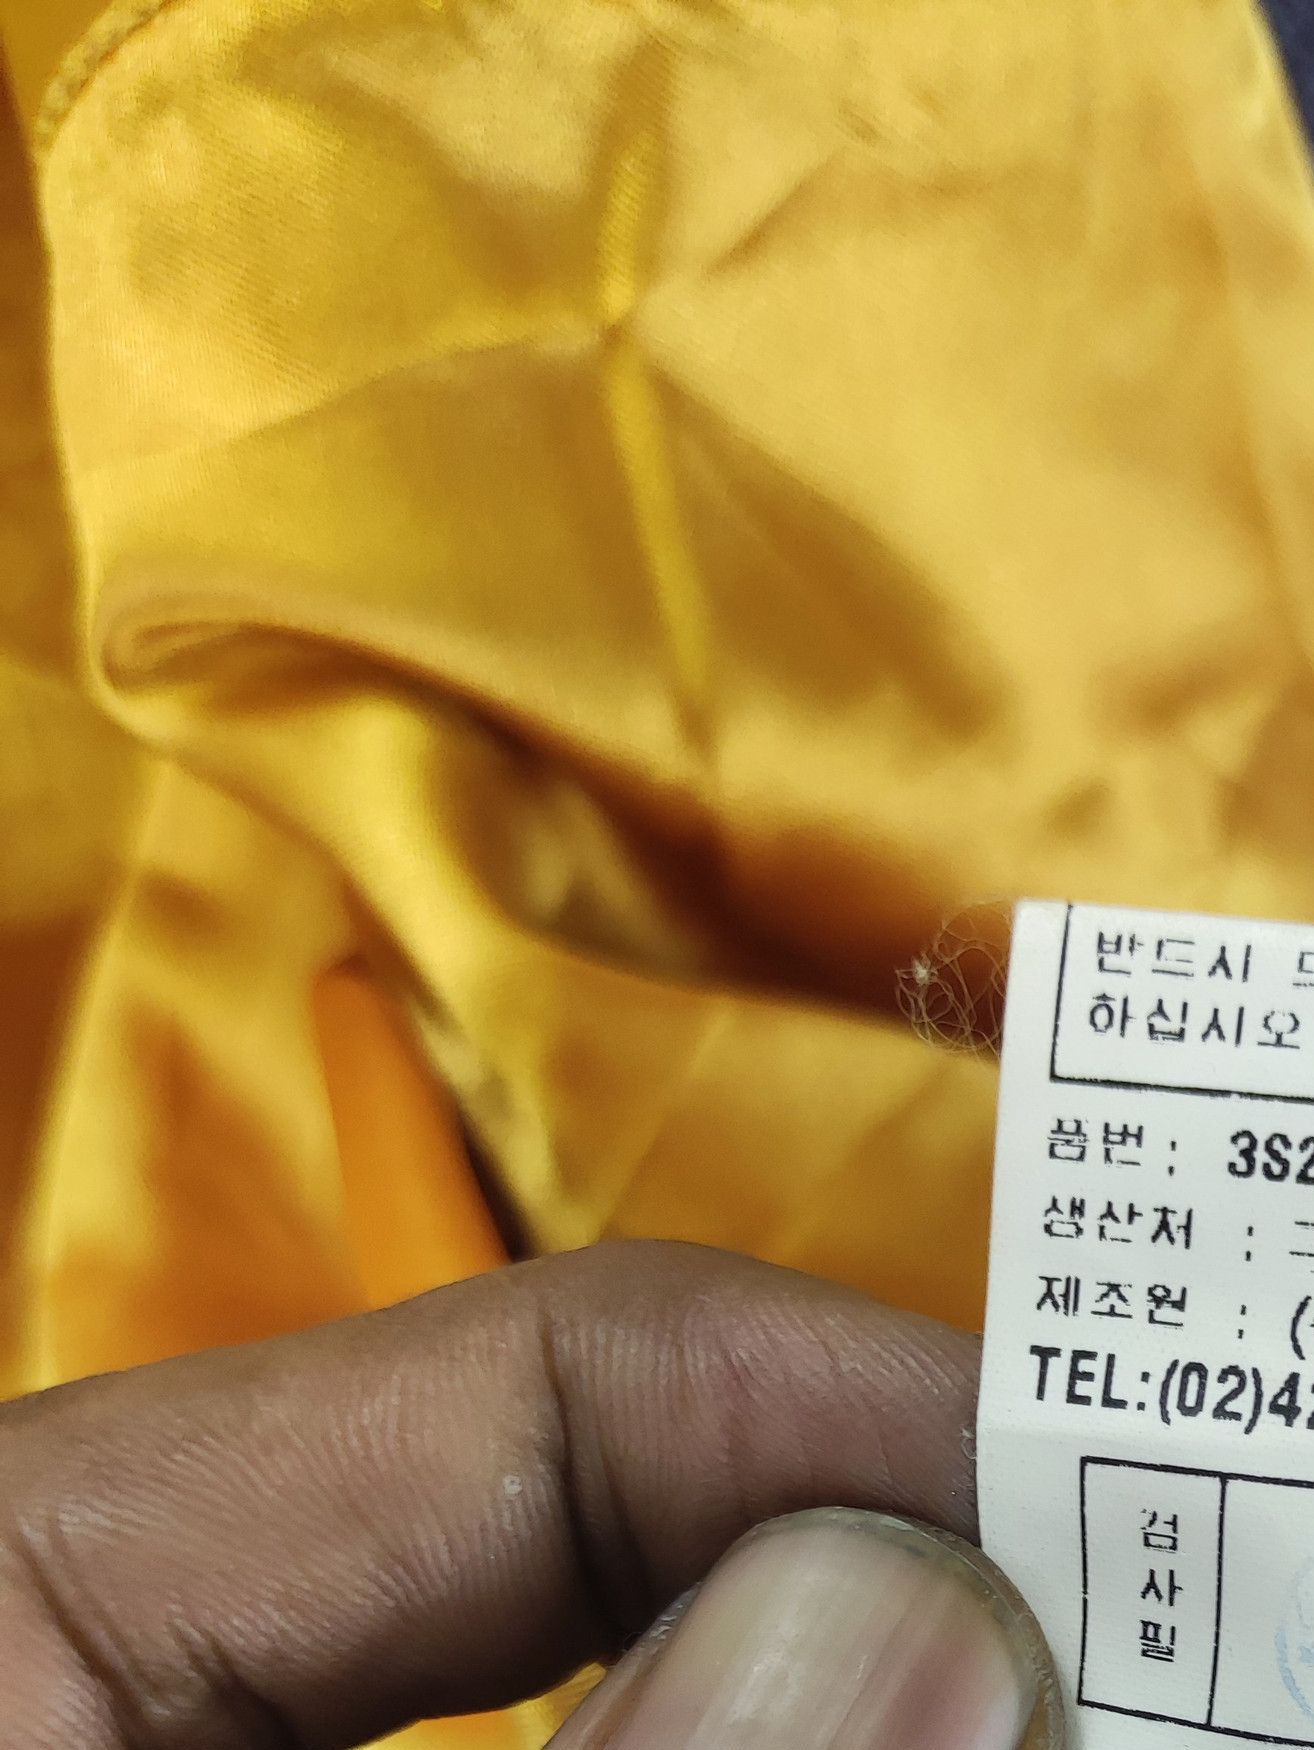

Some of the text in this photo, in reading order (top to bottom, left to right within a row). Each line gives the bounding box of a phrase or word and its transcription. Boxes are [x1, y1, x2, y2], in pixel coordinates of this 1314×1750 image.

[1096, 930, 1253, 984] 반드시
[1042, 1194, 1194, 1251] 생산처
[1035, 1274, 1188, 1331] 제조원
